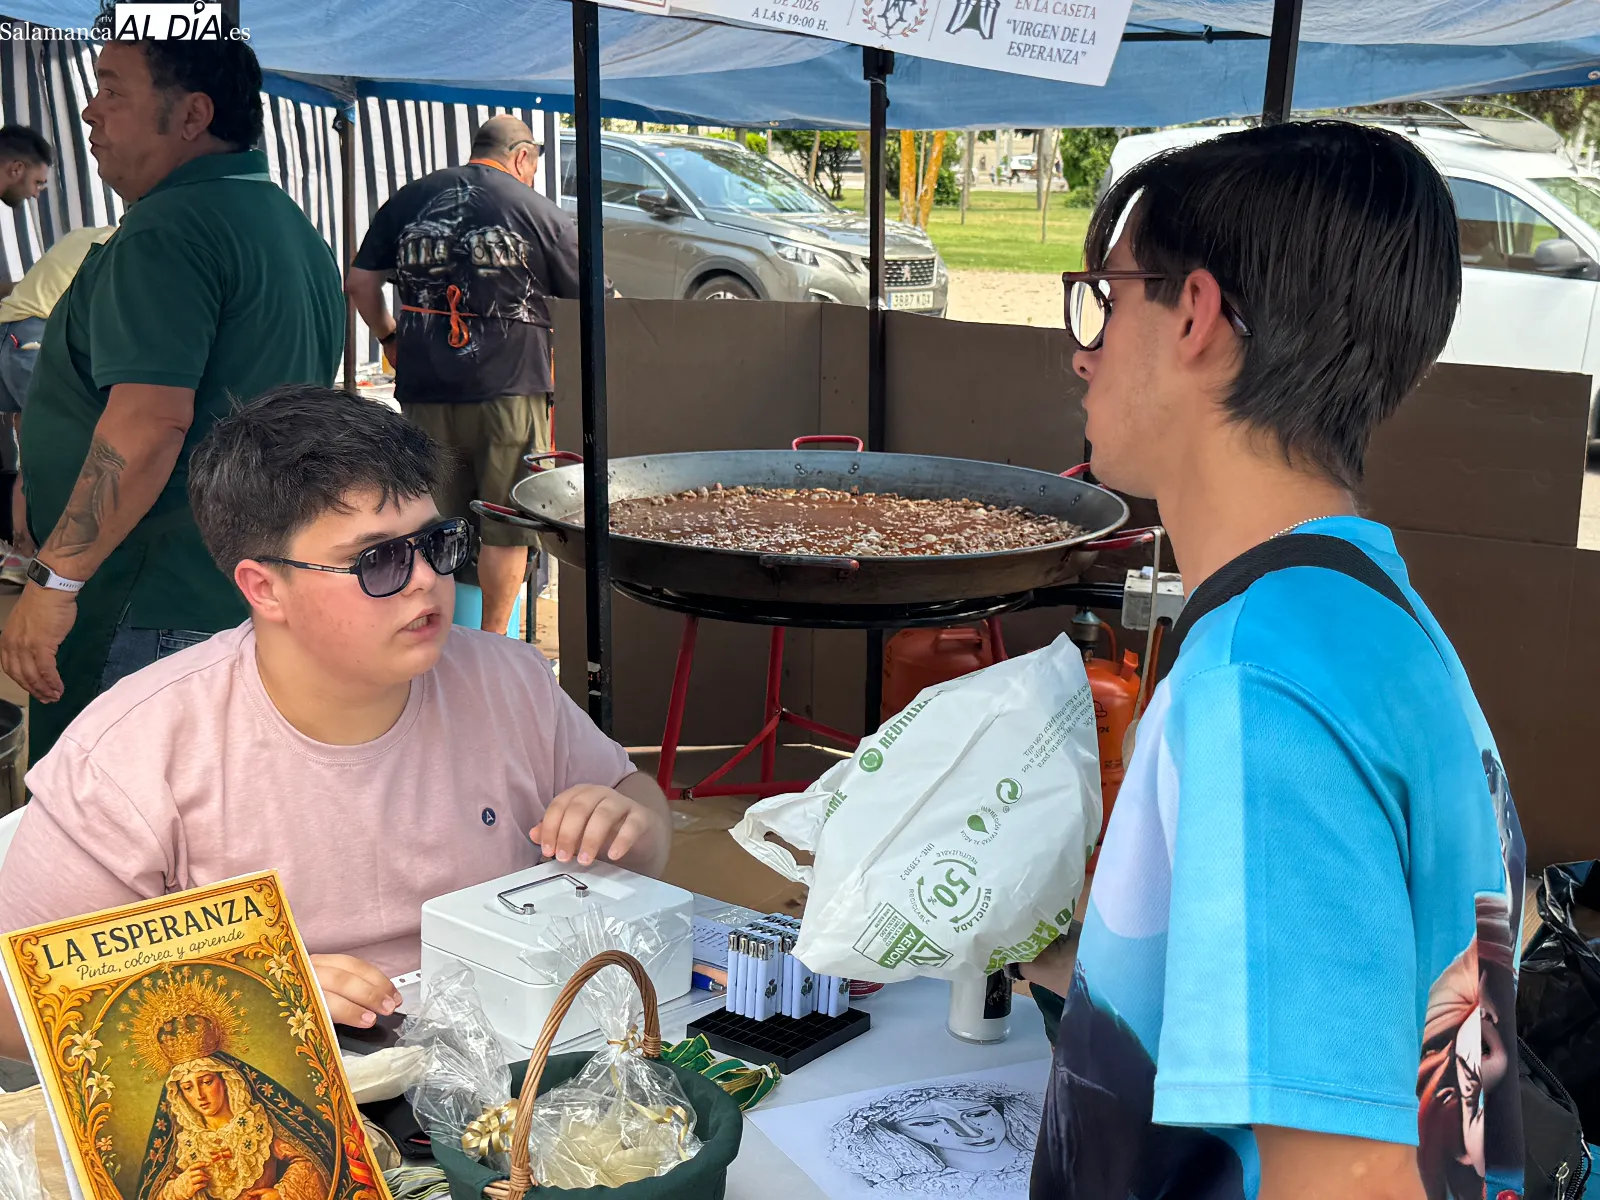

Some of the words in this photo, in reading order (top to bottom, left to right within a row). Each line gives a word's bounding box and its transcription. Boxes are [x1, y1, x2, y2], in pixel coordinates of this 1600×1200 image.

[751, 7, 759, 18] A
[762, 8, 784, 22] LAS
[787, 14, 815, 28] 19:00
[816, 19, 829, 31] H.
[1015, 0, 1032, 10] EN
[1033, 0, 1048, 13] LA
[1052, 1, 1096, 20] CASETA
[1060, 26, 1080, 43] DE
[1080, 28, 1096, 45] LA
[953, 888, 992, 933] RECICLADA
[42, 937, 87, 970] LA
[91, 895, 264, 958] ESPERANZA
[881, 928, 920, 968] AENOR
[77, 963, 122, 981] Pinta,
[124, 949, 173, 969] colorea
[176, 945, 185, 957] y
[189, 928, 245, 953] aprende
